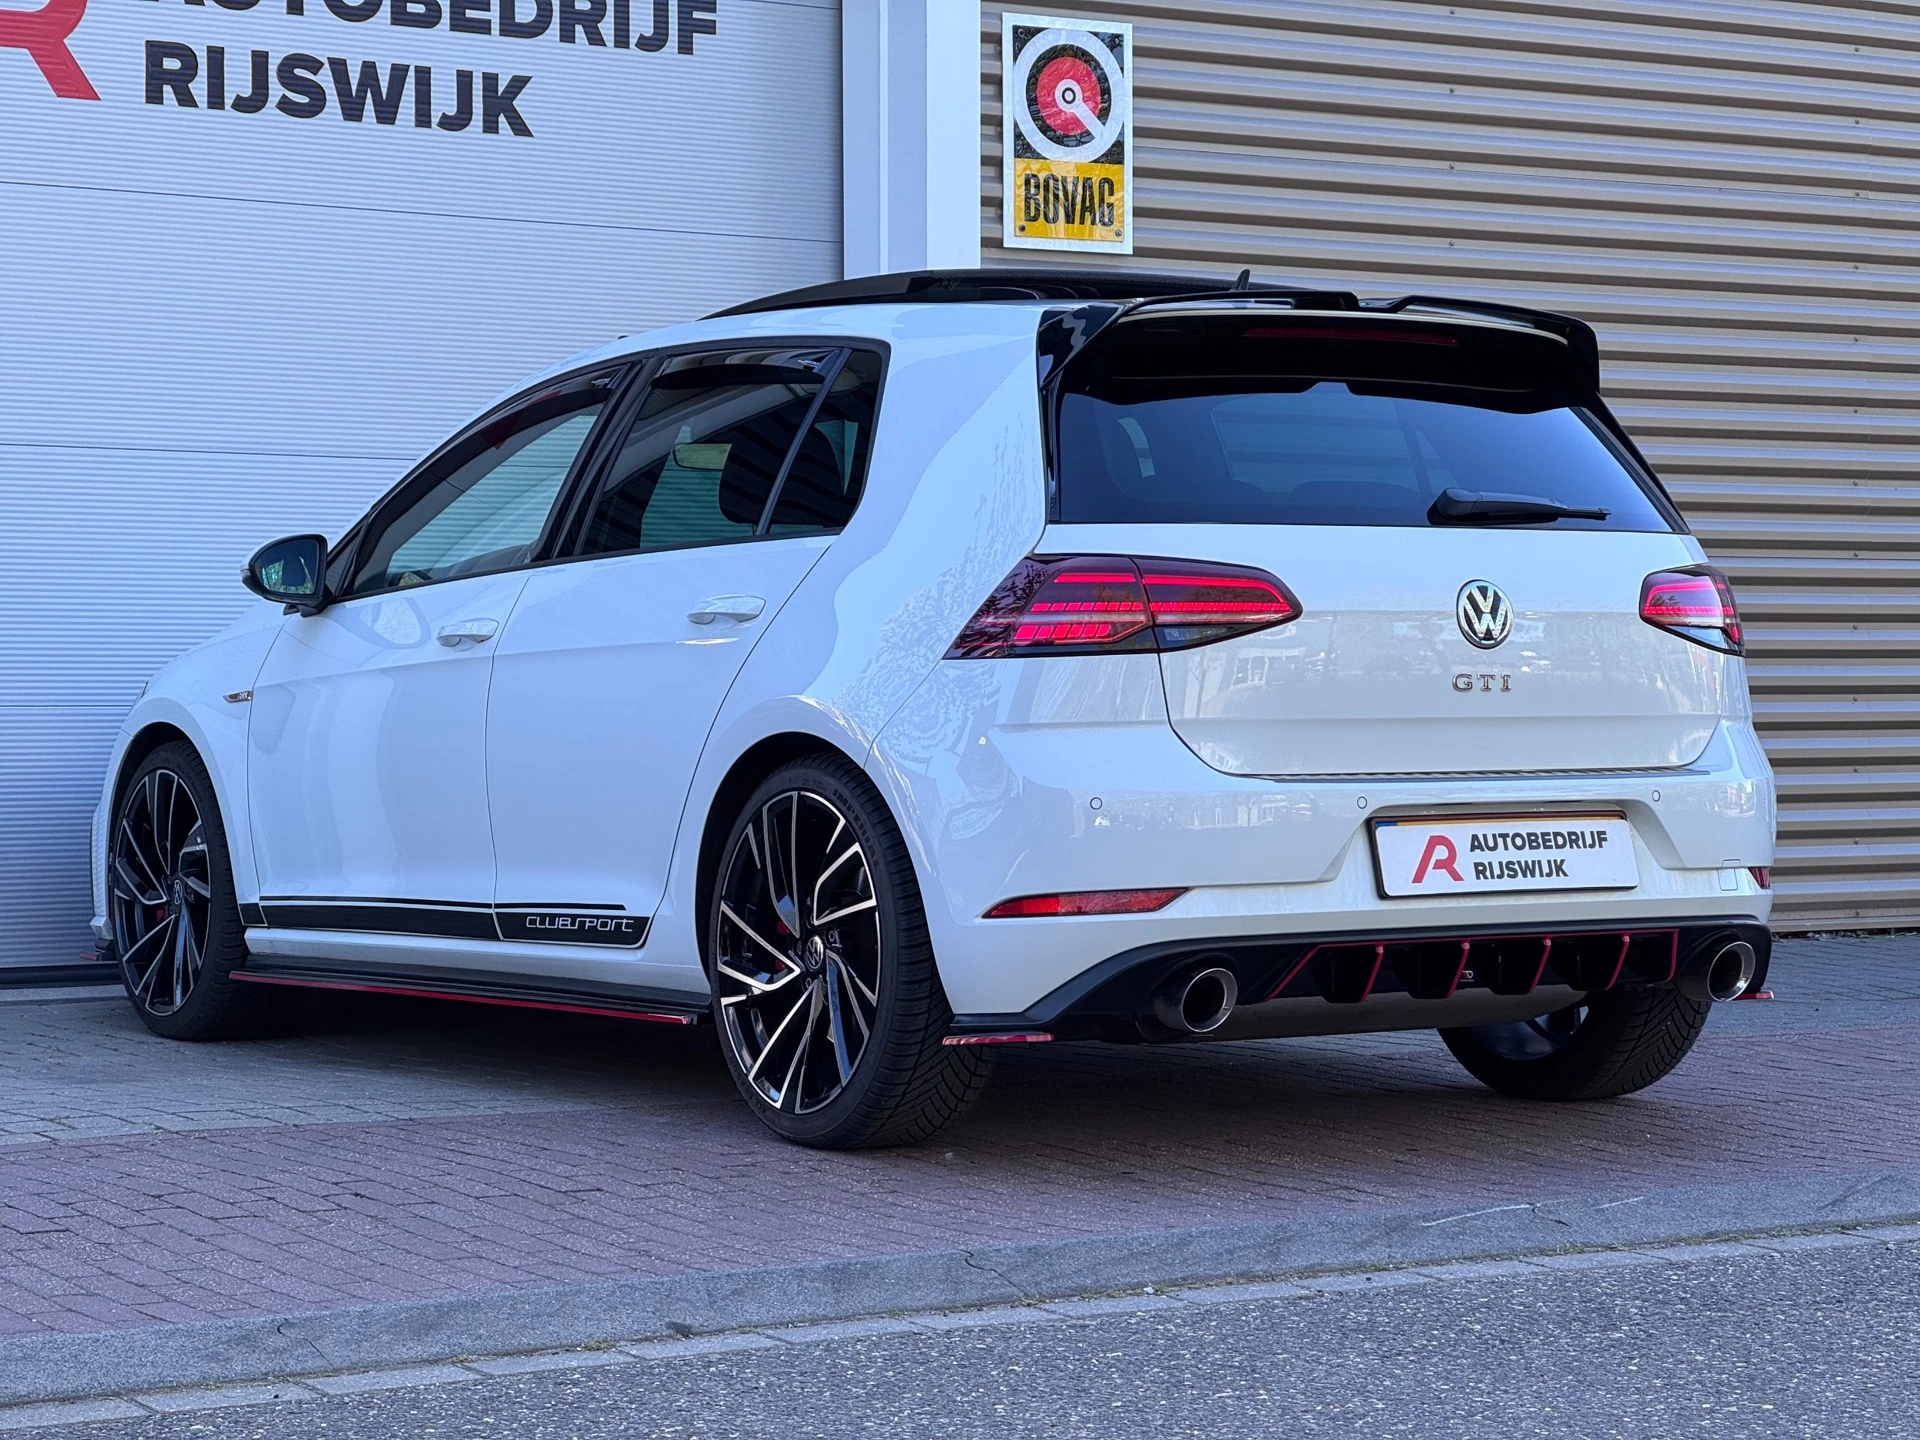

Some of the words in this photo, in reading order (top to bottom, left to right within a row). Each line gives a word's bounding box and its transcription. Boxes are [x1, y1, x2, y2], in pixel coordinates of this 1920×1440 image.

[144, 39, 535, 138] RIJSWIJK
[1024, 173, 1115, 227] BOVAG
[1452, 673, 1512, 692] GTI
[1469, 830, 1608, 853] AUTOBEDRIJF
[1473, 859, 1569, 881] RIJSWIJK
